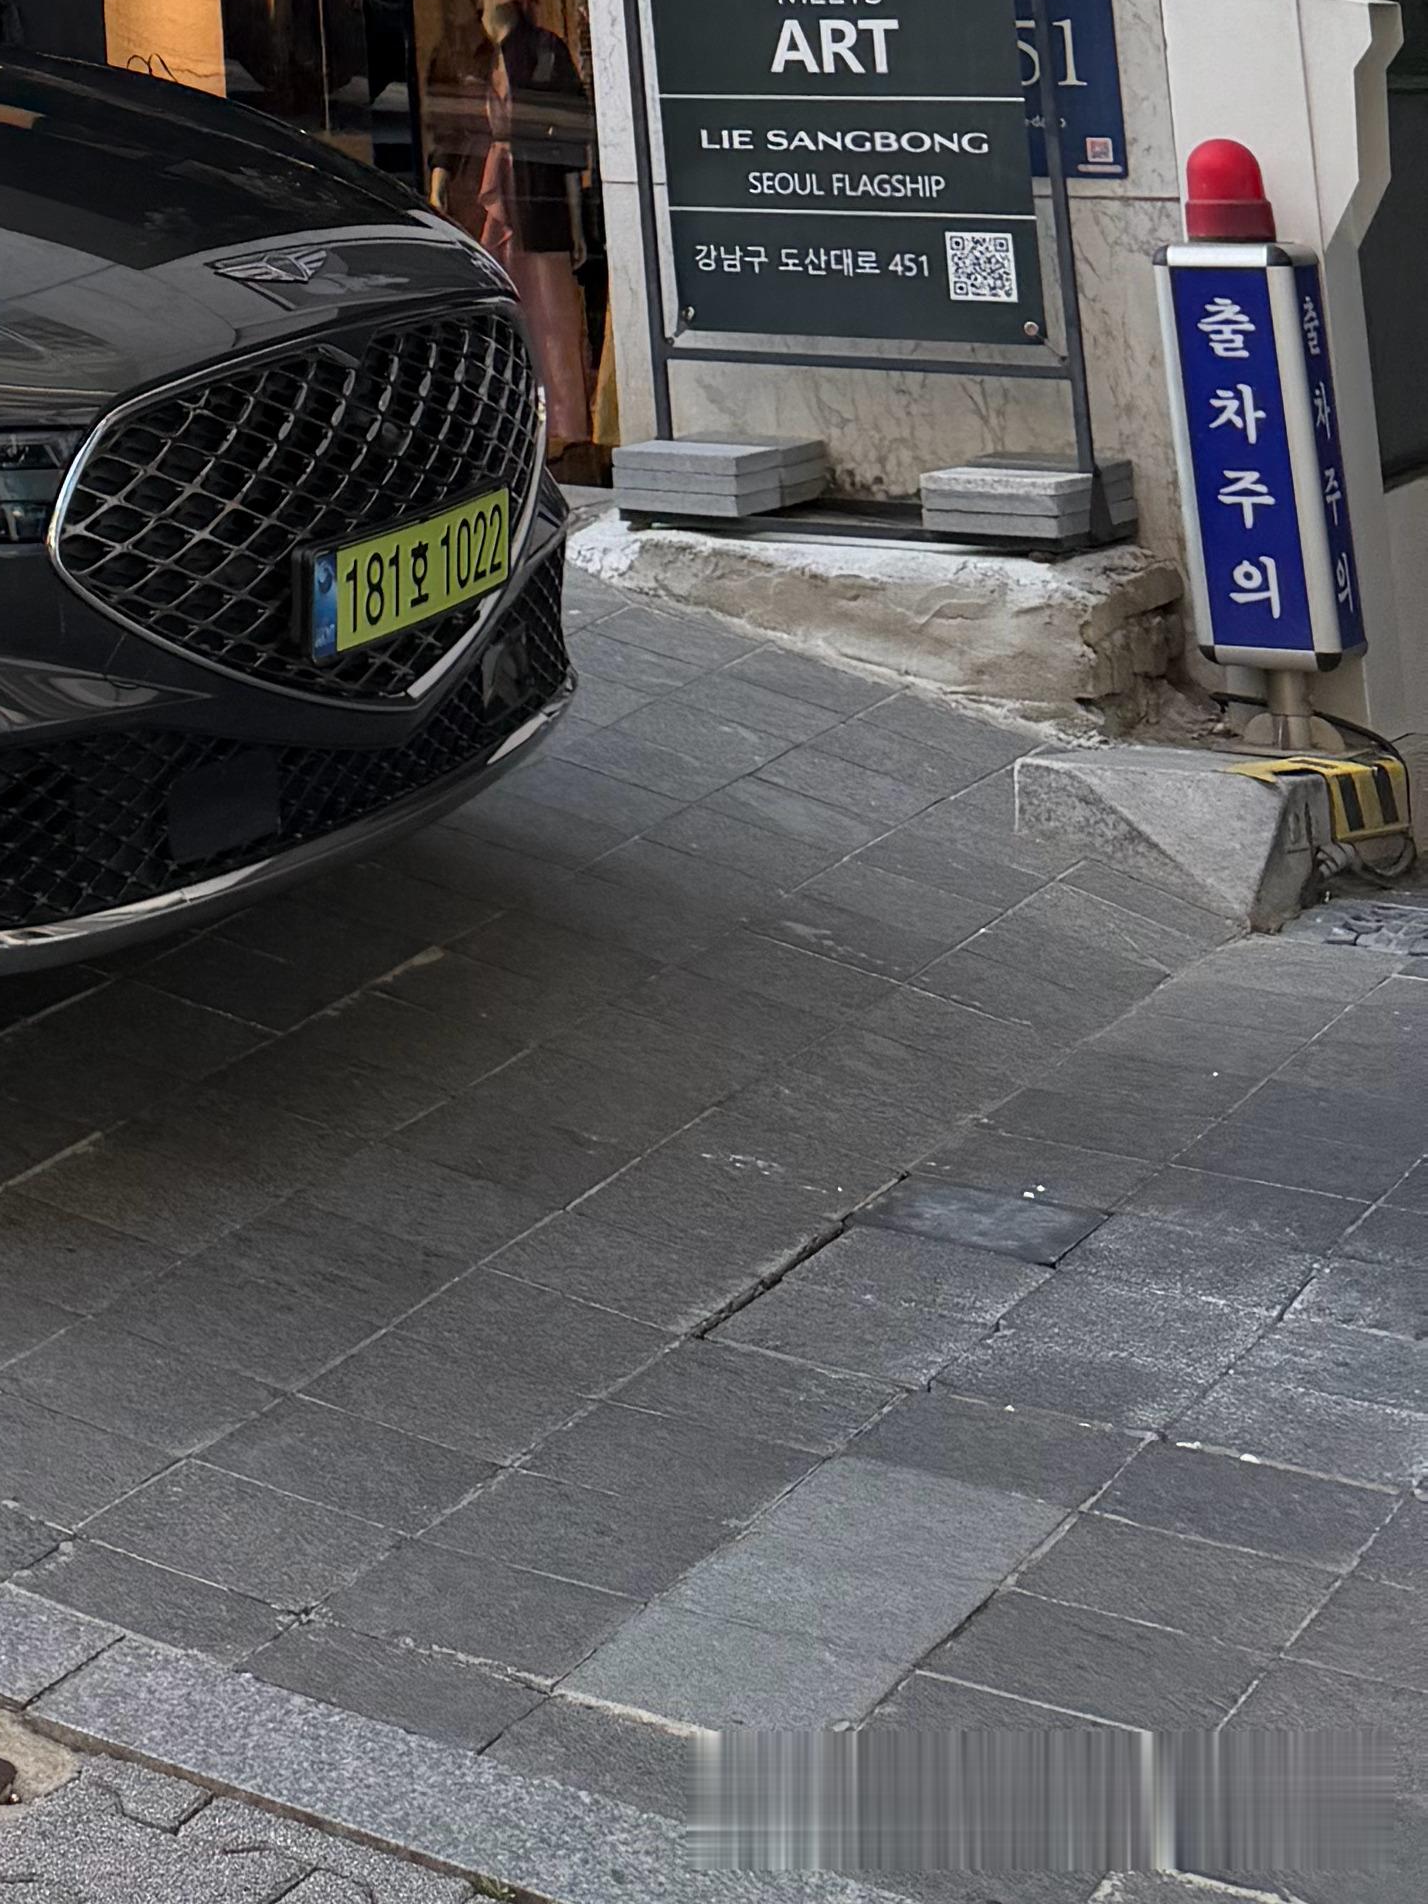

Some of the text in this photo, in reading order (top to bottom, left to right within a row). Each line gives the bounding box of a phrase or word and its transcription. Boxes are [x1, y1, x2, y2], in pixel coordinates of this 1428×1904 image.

[770, 19, 900, 74] ART
[1015, 18, 1088, 87] 51
[700, 129, 989, 154] LIE SANGBONG
[748, 172, 946, 198] SEOUL FLAGSHIP
[694, 244, 930, 277] 강남구 도산대로 451
[1197, 296, 1281, 620] 출차주의
[1303, 295, 1354, 614] 출차주의
[345, 503, 503, 634] 181호 1022
